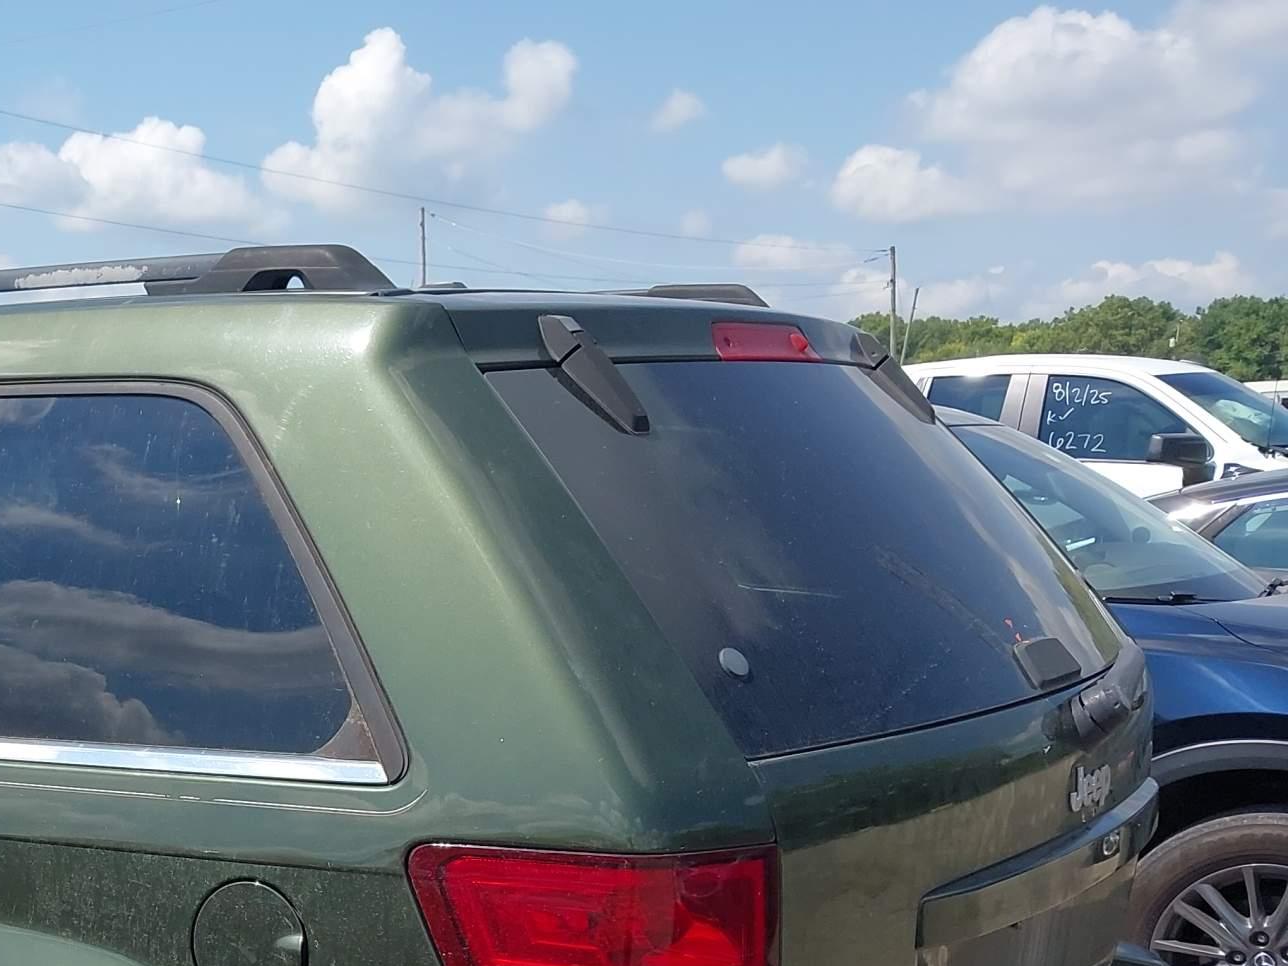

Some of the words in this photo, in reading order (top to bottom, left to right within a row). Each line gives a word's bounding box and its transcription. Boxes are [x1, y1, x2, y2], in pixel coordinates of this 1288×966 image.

[1052, 381, 1112, 406] 8/2/25
[1048, 431, 1107, 453] 6272
[1070, 764, 1111, 812] Jeep
